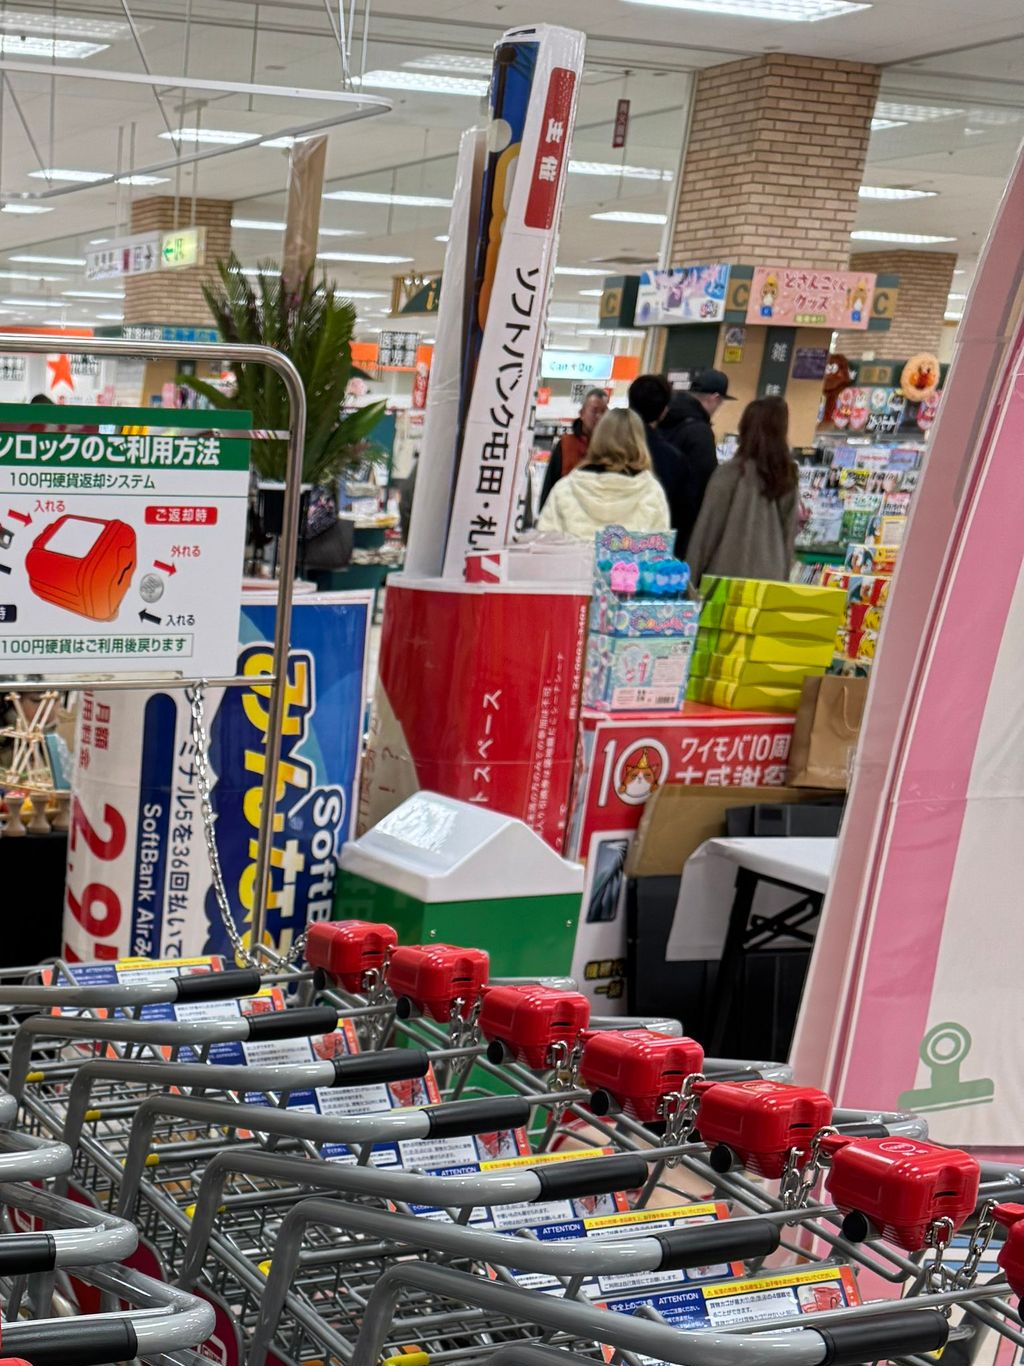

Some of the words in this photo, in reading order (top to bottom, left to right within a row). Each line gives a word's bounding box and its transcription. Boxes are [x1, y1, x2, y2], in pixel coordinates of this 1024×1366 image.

[538, 118, 564, 182] 主催
[795, 294, 828, 310] グッズ
[467, 266, 540, 551] ソフトバンク屯田・札
[9, 471, 156, 490] 100円硬貨返却システム
[34, 500, 66, 513] 入れる
[155, 508, 208, 522] ご返却時
[170, 545, 201, 558] 外れる
[166, 614, 196, 627] 入れる
[1, 636, 187, 655] 100円硬貨はご利用後戻ります
[95, 702, 111, 750] 月額
[598, 736, 670, 806] 10
[137, 802, 163, 902] SoftBank
[542, 1223, 581, 1235] ATTENTION
[658, 1292, 699, 1306] ATTENTION
